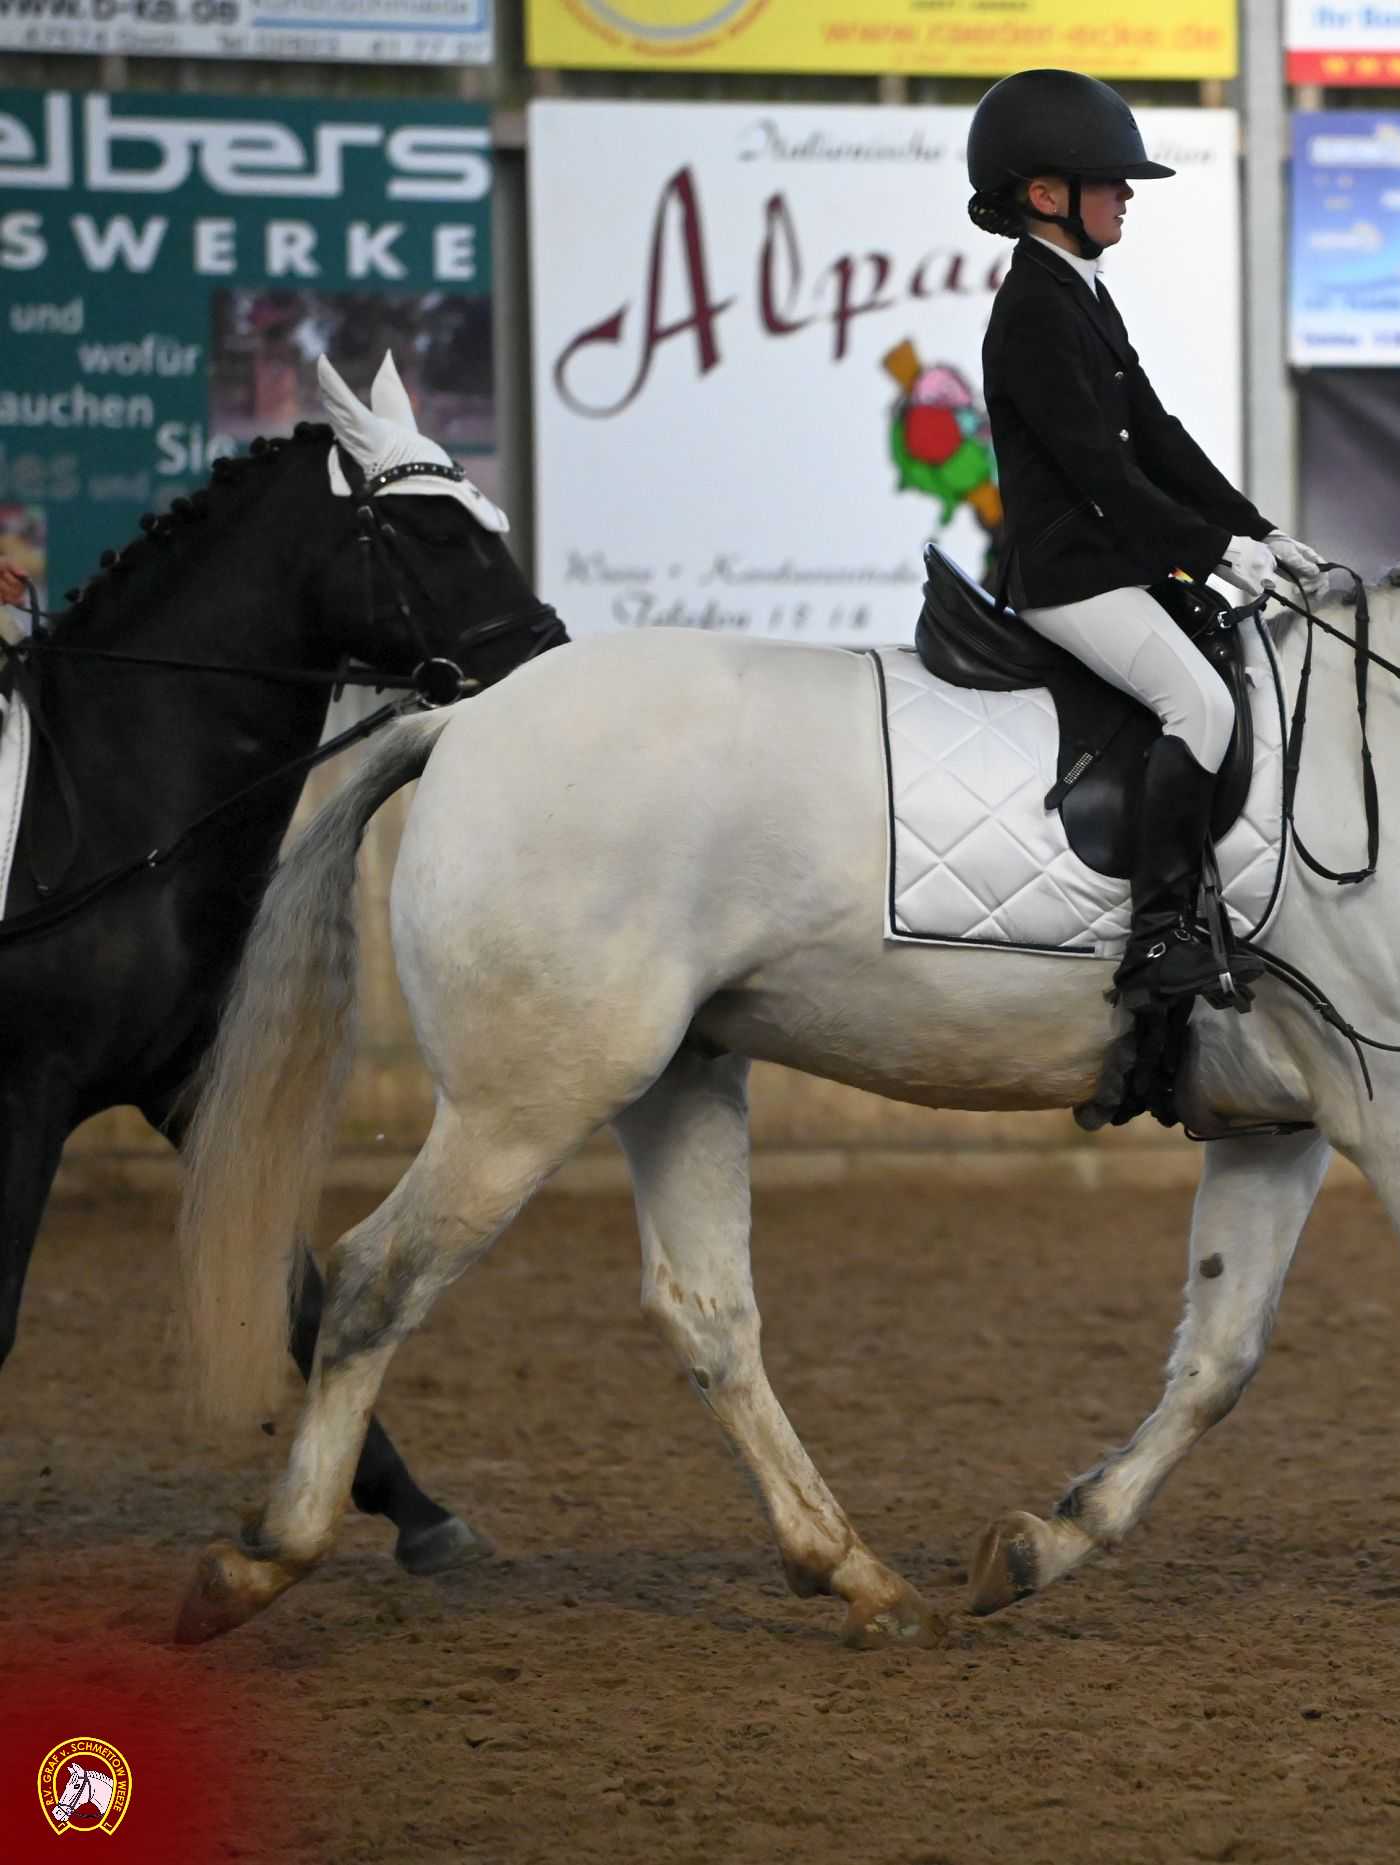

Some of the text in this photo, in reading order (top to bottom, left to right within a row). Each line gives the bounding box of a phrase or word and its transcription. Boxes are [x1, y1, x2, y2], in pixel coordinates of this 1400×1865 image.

[9, 299, 85, 335] und
[77, 333, 201, 376] wofür
[155, 422, 238, 475] Sie
